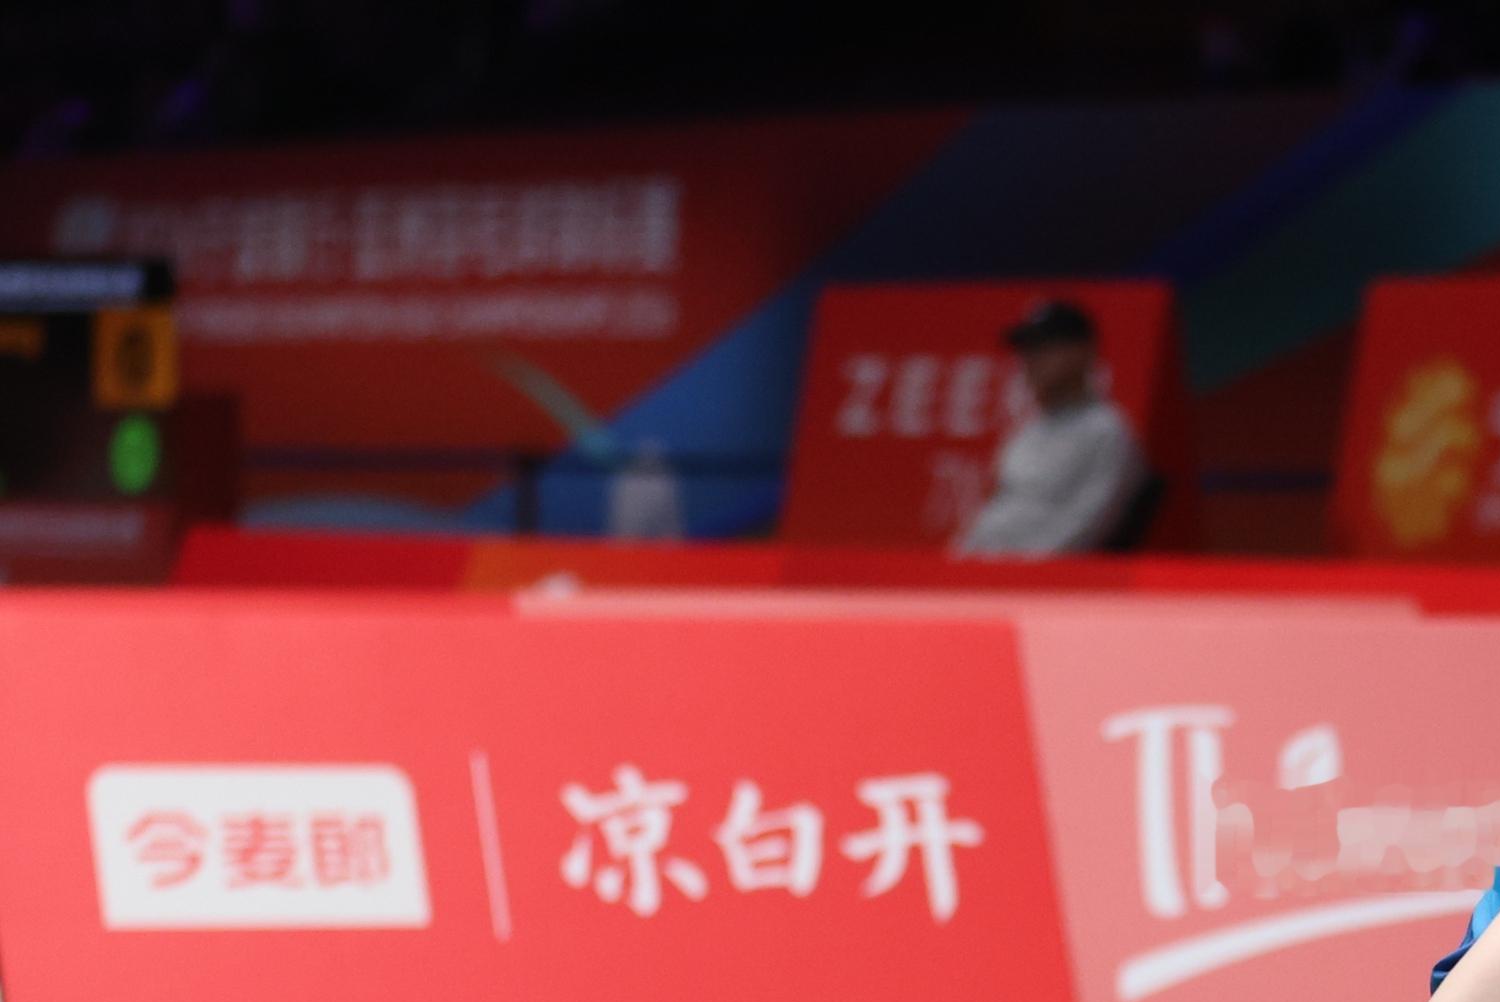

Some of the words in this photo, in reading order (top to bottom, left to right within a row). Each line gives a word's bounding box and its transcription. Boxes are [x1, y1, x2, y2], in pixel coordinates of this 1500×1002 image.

[124, 809, 391, 894] 今麦郎
[559, 763, 984, 924] 凉白开
